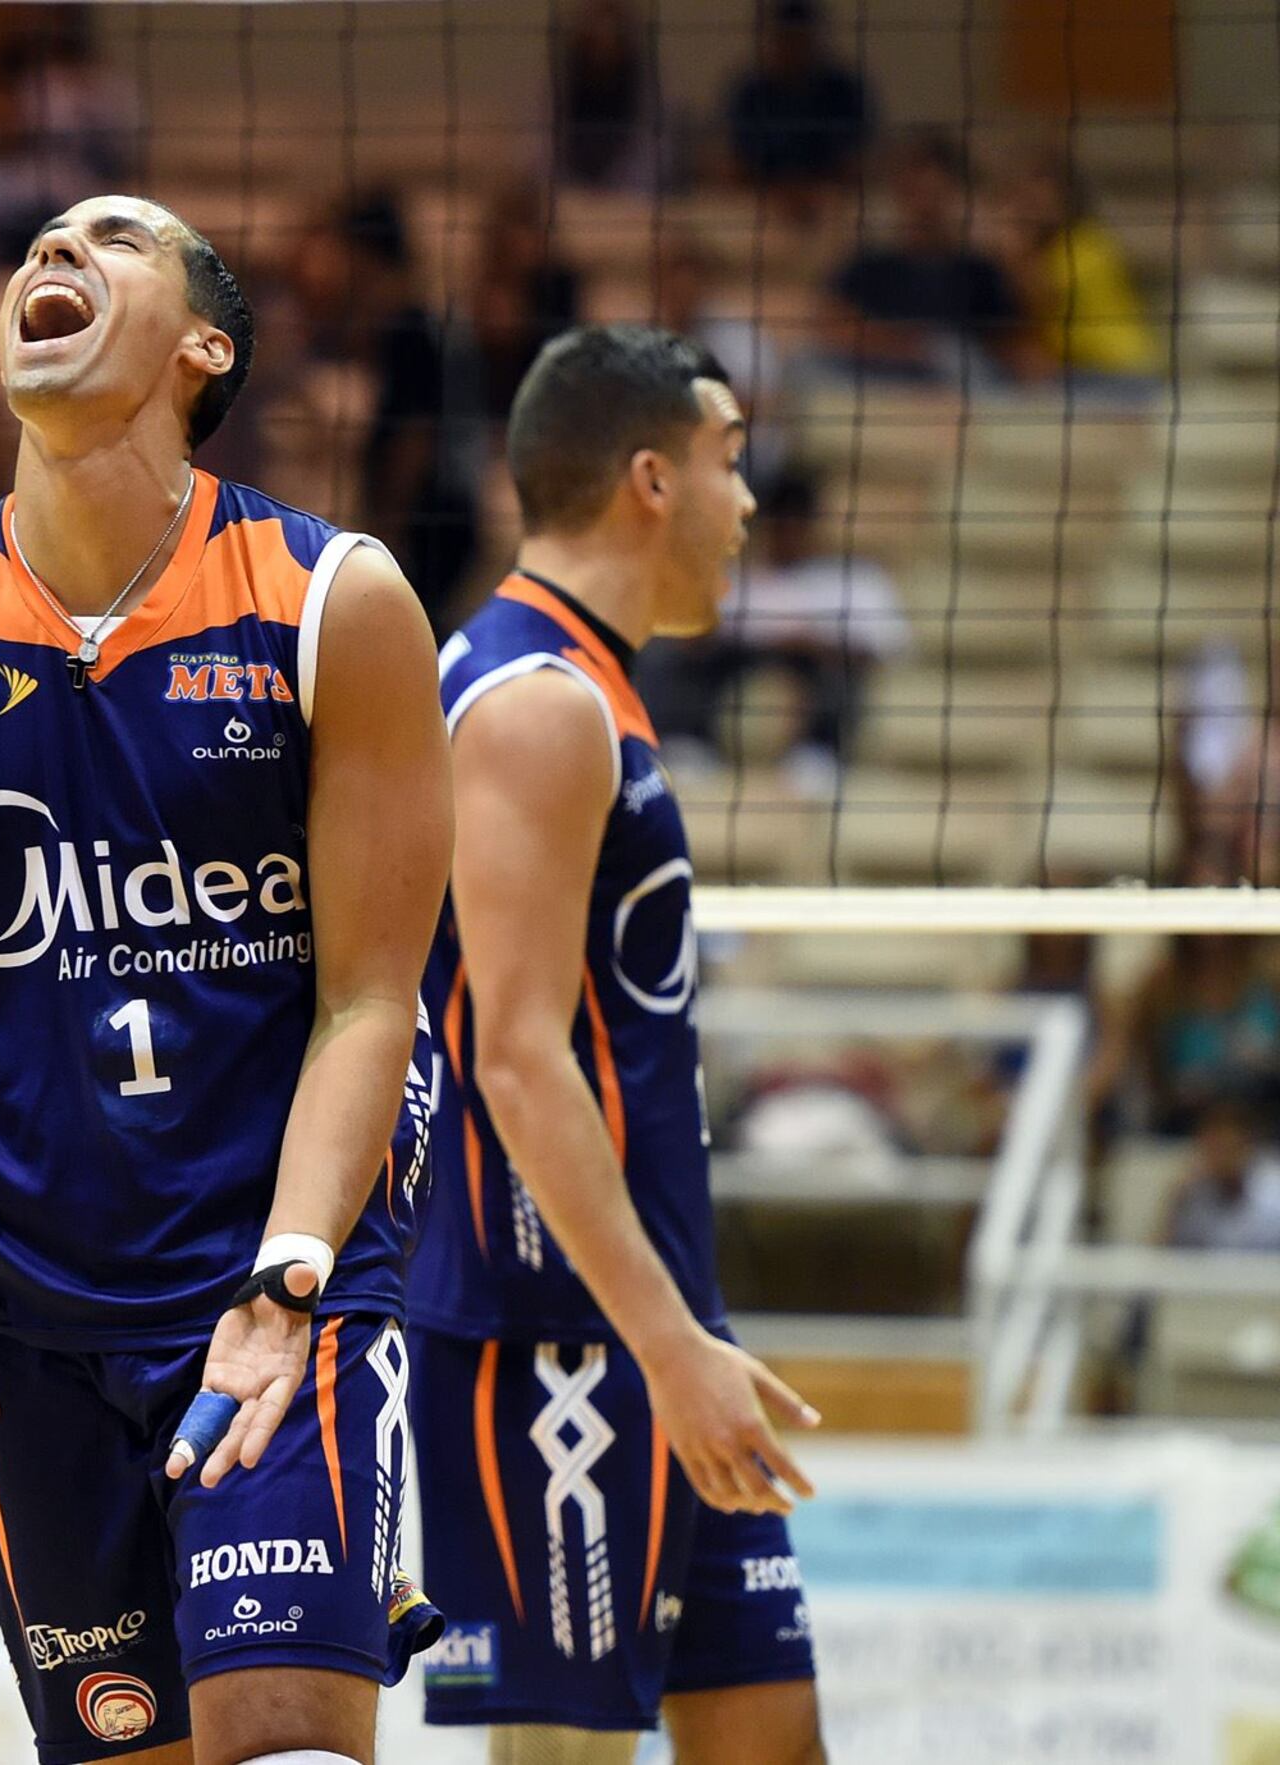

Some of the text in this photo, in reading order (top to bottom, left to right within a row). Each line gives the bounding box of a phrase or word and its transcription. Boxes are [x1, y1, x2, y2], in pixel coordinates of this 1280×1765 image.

[58, 932, 312, 981] Air Conditioning
[109, 999, 172, 1096] 1
[190, 1539, 334, 1589] HONDA
[740, 1555, 801, 1592] HON
